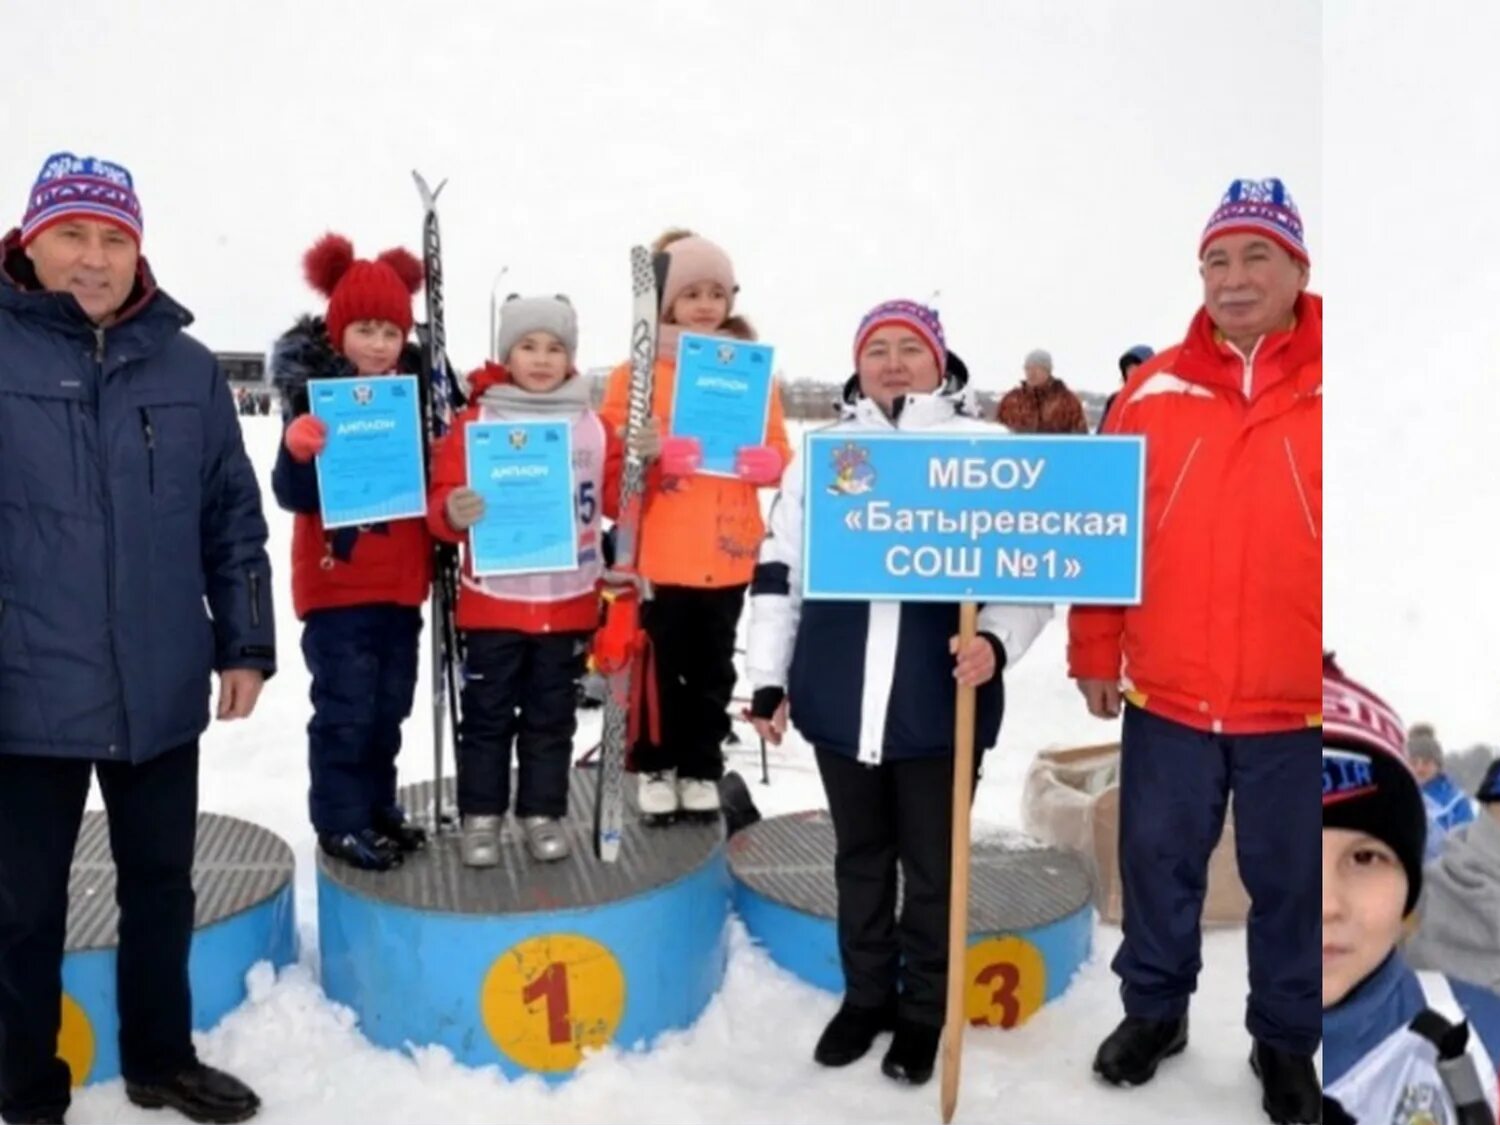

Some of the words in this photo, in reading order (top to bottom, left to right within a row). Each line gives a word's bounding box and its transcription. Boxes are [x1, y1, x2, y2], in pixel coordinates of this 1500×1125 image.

[928, 457, 1046, 490] МБОУ
[575, 480, 597, 525] 5
[844, 500, 1128, 540] «Батыревская
[885, 546, 981, 578] СОШ
[996, 549, 1082, 578] №1»
[522, 961, 573, 1046] 1
[970, 962, 1022, 1030] 3
